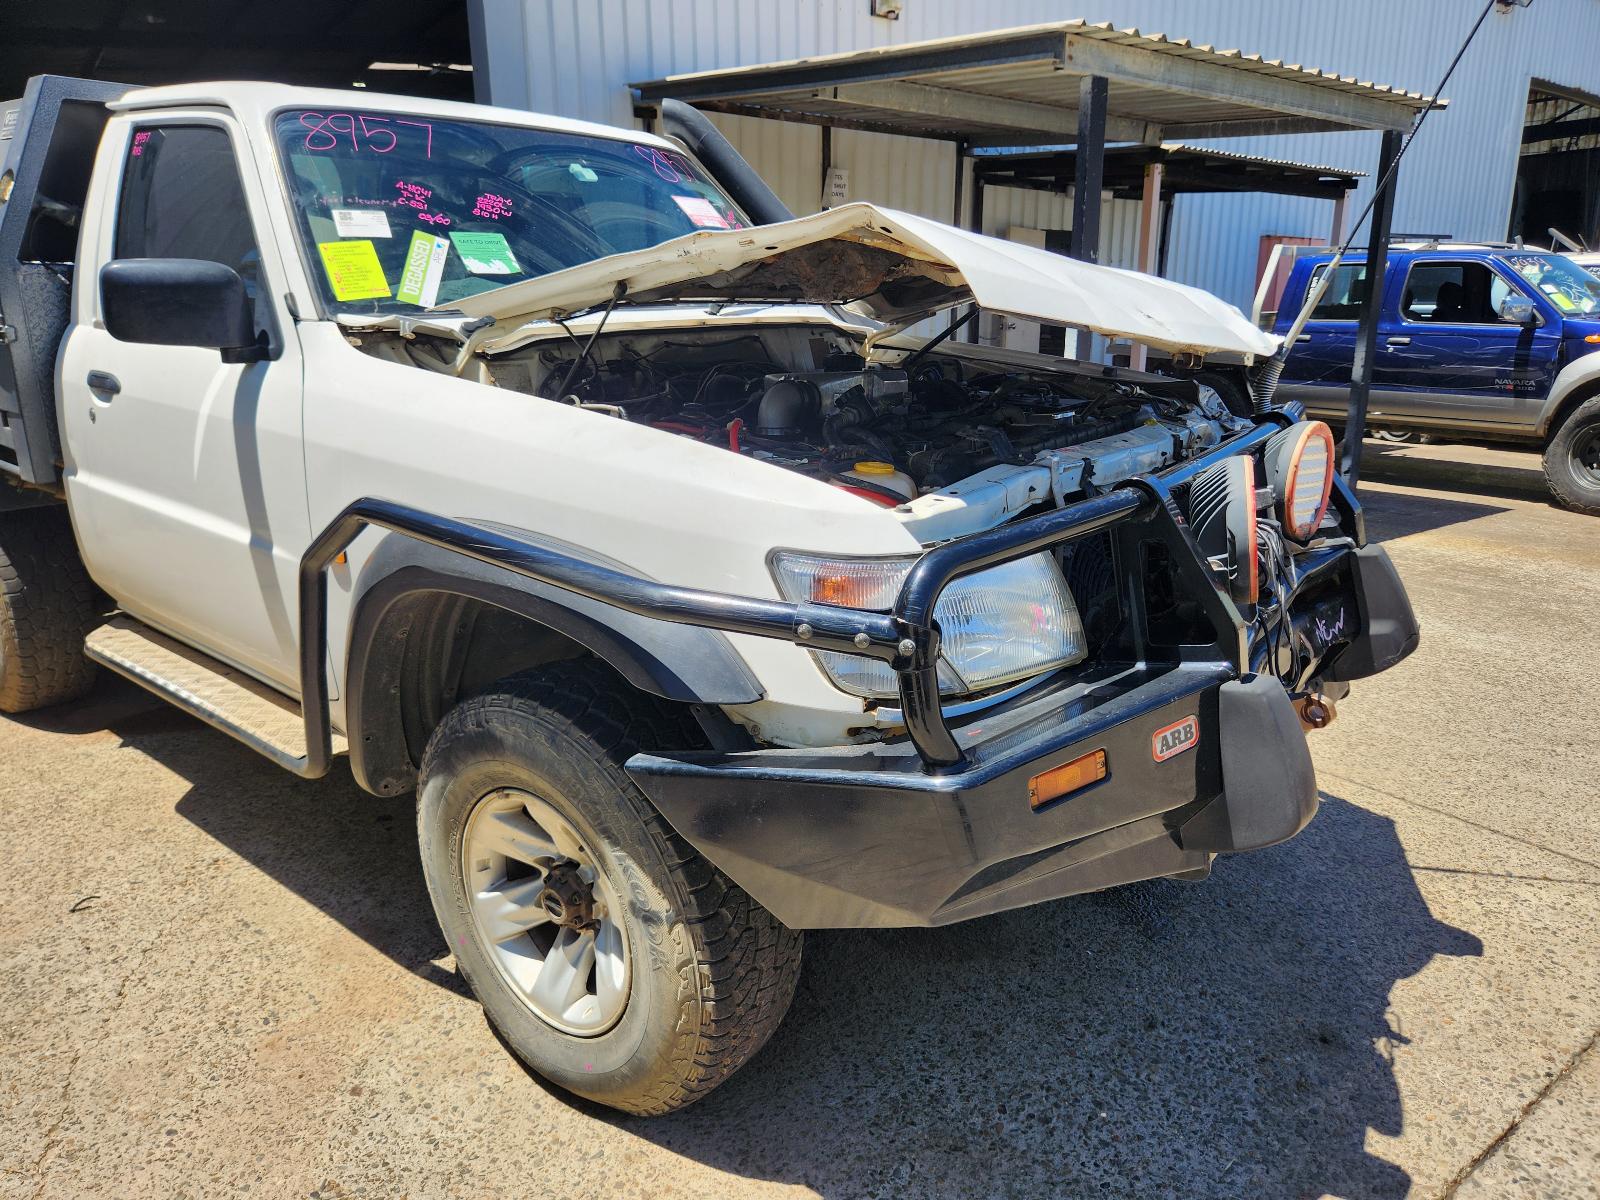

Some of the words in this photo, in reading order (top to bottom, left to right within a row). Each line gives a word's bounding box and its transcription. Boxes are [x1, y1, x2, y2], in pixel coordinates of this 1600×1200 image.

[300, 112, 432, 159] 8957
[402, 239, 431, 295] DEGASSED
[1160, 724, 1194, 754] ARB
